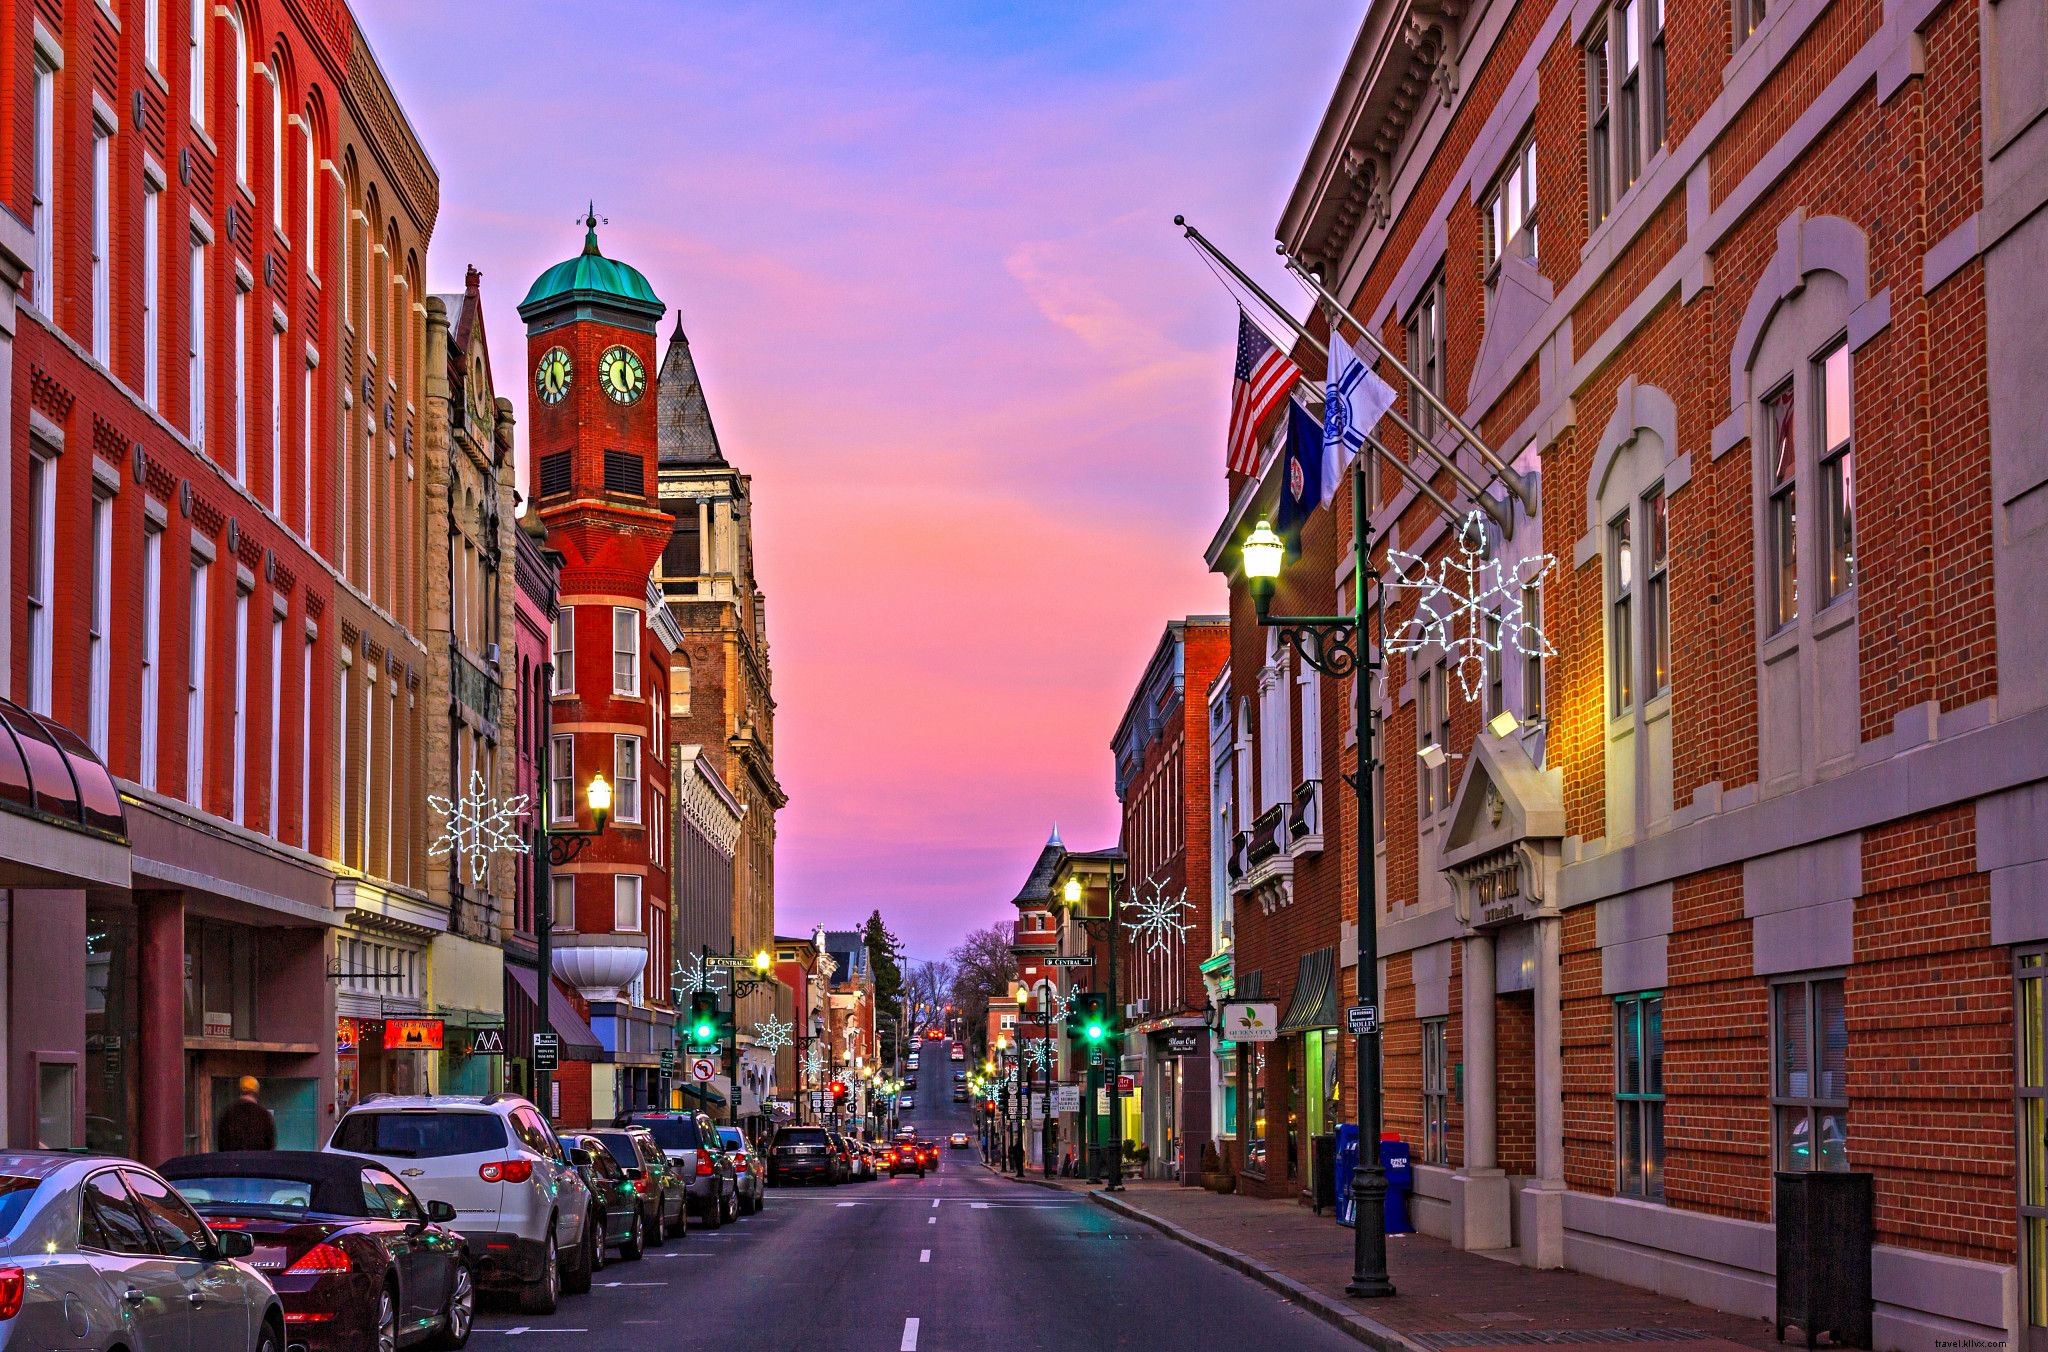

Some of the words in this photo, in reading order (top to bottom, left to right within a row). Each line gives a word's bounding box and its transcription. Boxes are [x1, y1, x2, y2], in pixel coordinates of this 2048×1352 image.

[1498, 866, 1519, 900] HALL
[1349, 1020, 1376, 1028] TROLLEY
[214, 1025, 230, 1035] LEASE
[474, 1031, 504, 1050] AVA
[1168, 1037, 1185, 1046] Blow
